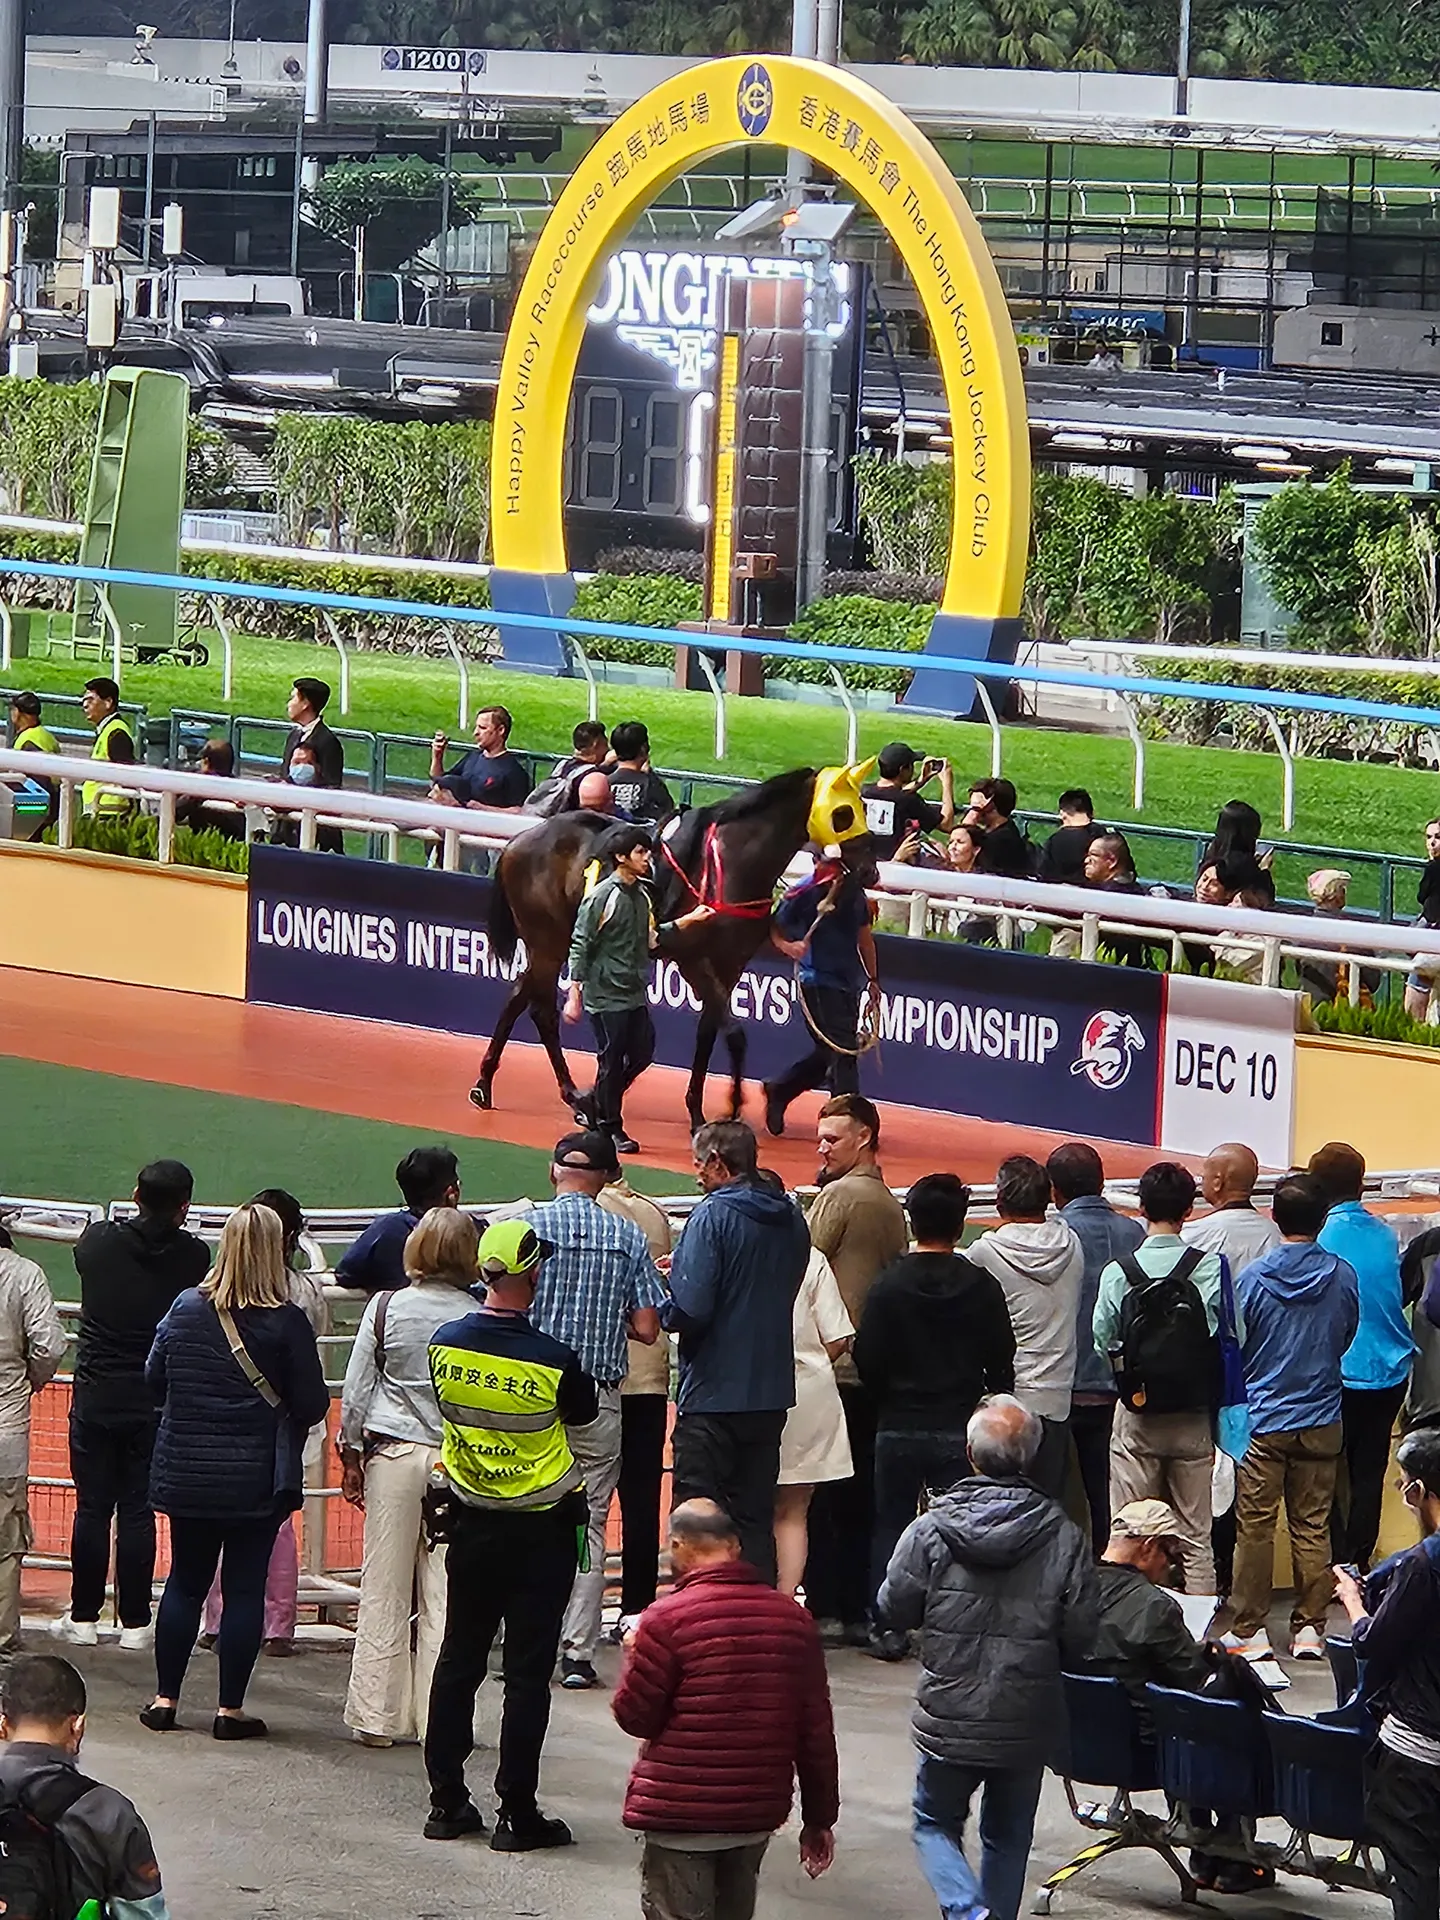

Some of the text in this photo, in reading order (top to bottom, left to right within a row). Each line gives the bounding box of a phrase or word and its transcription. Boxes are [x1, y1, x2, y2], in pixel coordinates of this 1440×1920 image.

[407, 50, 461, 70] 1200
[606, 92, 709, 188] 跑馬地馬場
[800, 95, 901, 195] 香港賽馬會
[507, 182, 604, 514] Happy Valley Racecourse
[902, 185, 990, 557] The Hong Kong Jockey Club
[257, 899, 396, 963] LONGINES
[1175, 1039, 1277, 1101] DEC 10
